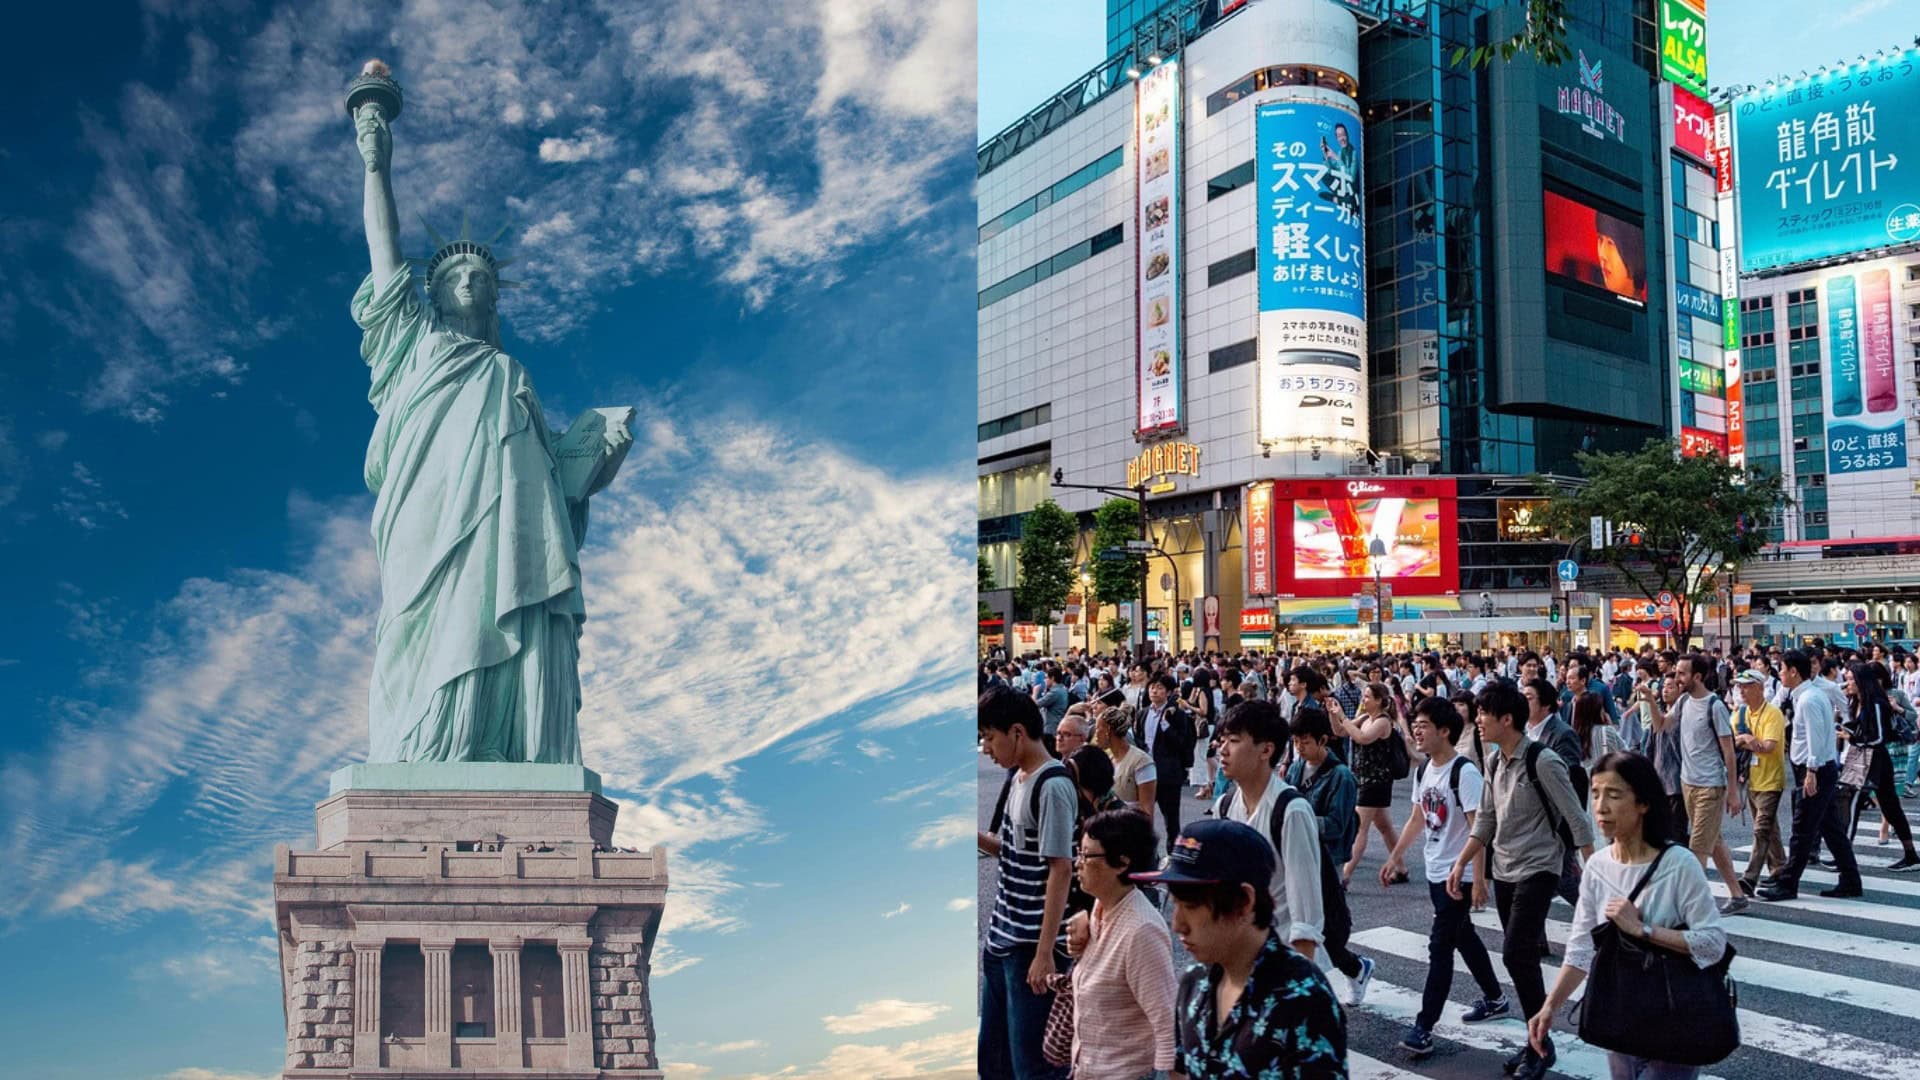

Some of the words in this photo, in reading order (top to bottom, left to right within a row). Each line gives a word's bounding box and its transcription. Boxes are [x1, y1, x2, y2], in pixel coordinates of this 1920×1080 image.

[1663, 2, 1705, 48] レイク
[1664, 35, 1706, 80] ALSA
[1741, 62, 1913, 116] のど、直接、うるおう
[1558, 86, 1625, 143] MAGNET
[1674, 103, 1714, 142] アイフル
[1777, 100, 1877, 163] 龍角散
[1271, 141, 1307, 158] その
[1271, 162, 1360, 206] スマホ、
[1765, 149, 1897, 209] ダイレクト
[1778, 208, 1833, 229] スティック
[1272, 222, 1361, 269] 軽くして
[1299, 395, 1353, 409] DIGA
[1729, 401, 1740, 431] アコム
[1832, 432, 1905, 451] のど、直接、
[1839, 451, 1894, 470] うるおう
[1127, 441, 1201, 489] MAGNET
[1253, 505, 1266, 591] 天津甘栗
